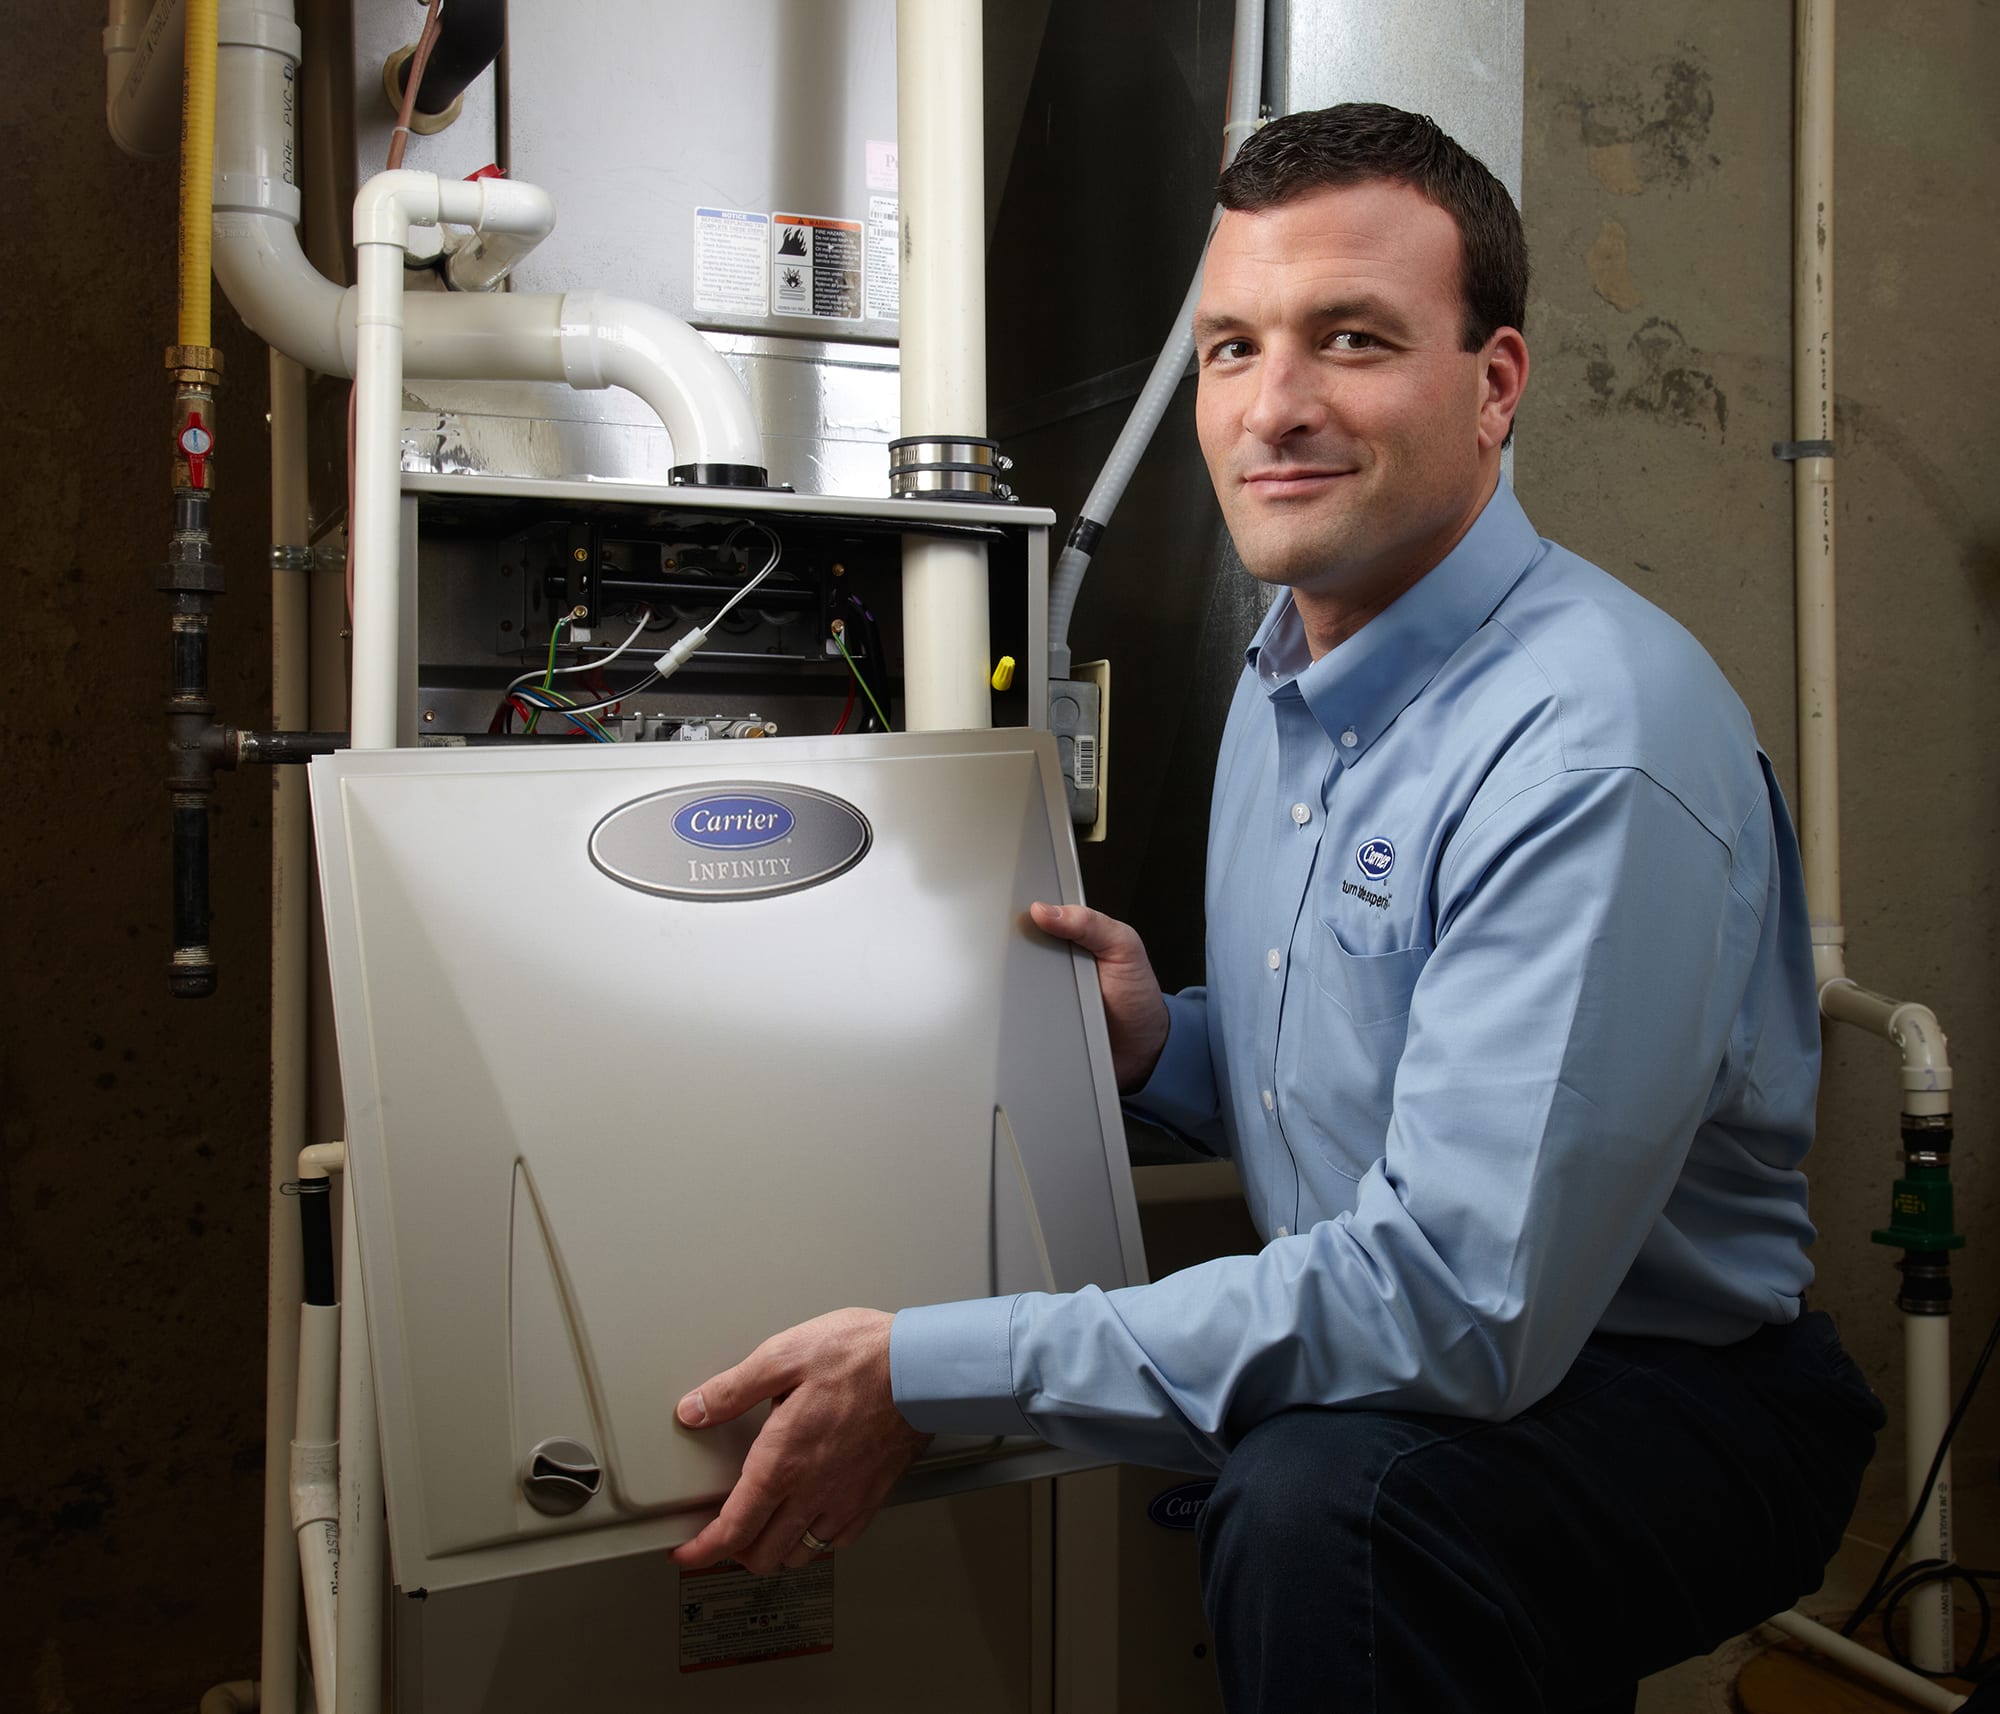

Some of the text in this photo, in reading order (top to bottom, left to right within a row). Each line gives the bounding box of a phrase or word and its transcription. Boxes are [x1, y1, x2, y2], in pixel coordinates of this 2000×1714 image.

[283, 137, 293, 185] CORE
[721, 212, 746, 220] NOTICE
[808, 220, 839, 229] WARNING
[690, 808, 779, 833] Carrier
[688, 857, 792, 882] INFINITY
[1363, 844, 1392, 870] Carrier
[1342, 879, 1358, 897] turn
[1939, 1509, 1949, 1538] EAGLE
[325, 1523, 338, 1555] ASTM
